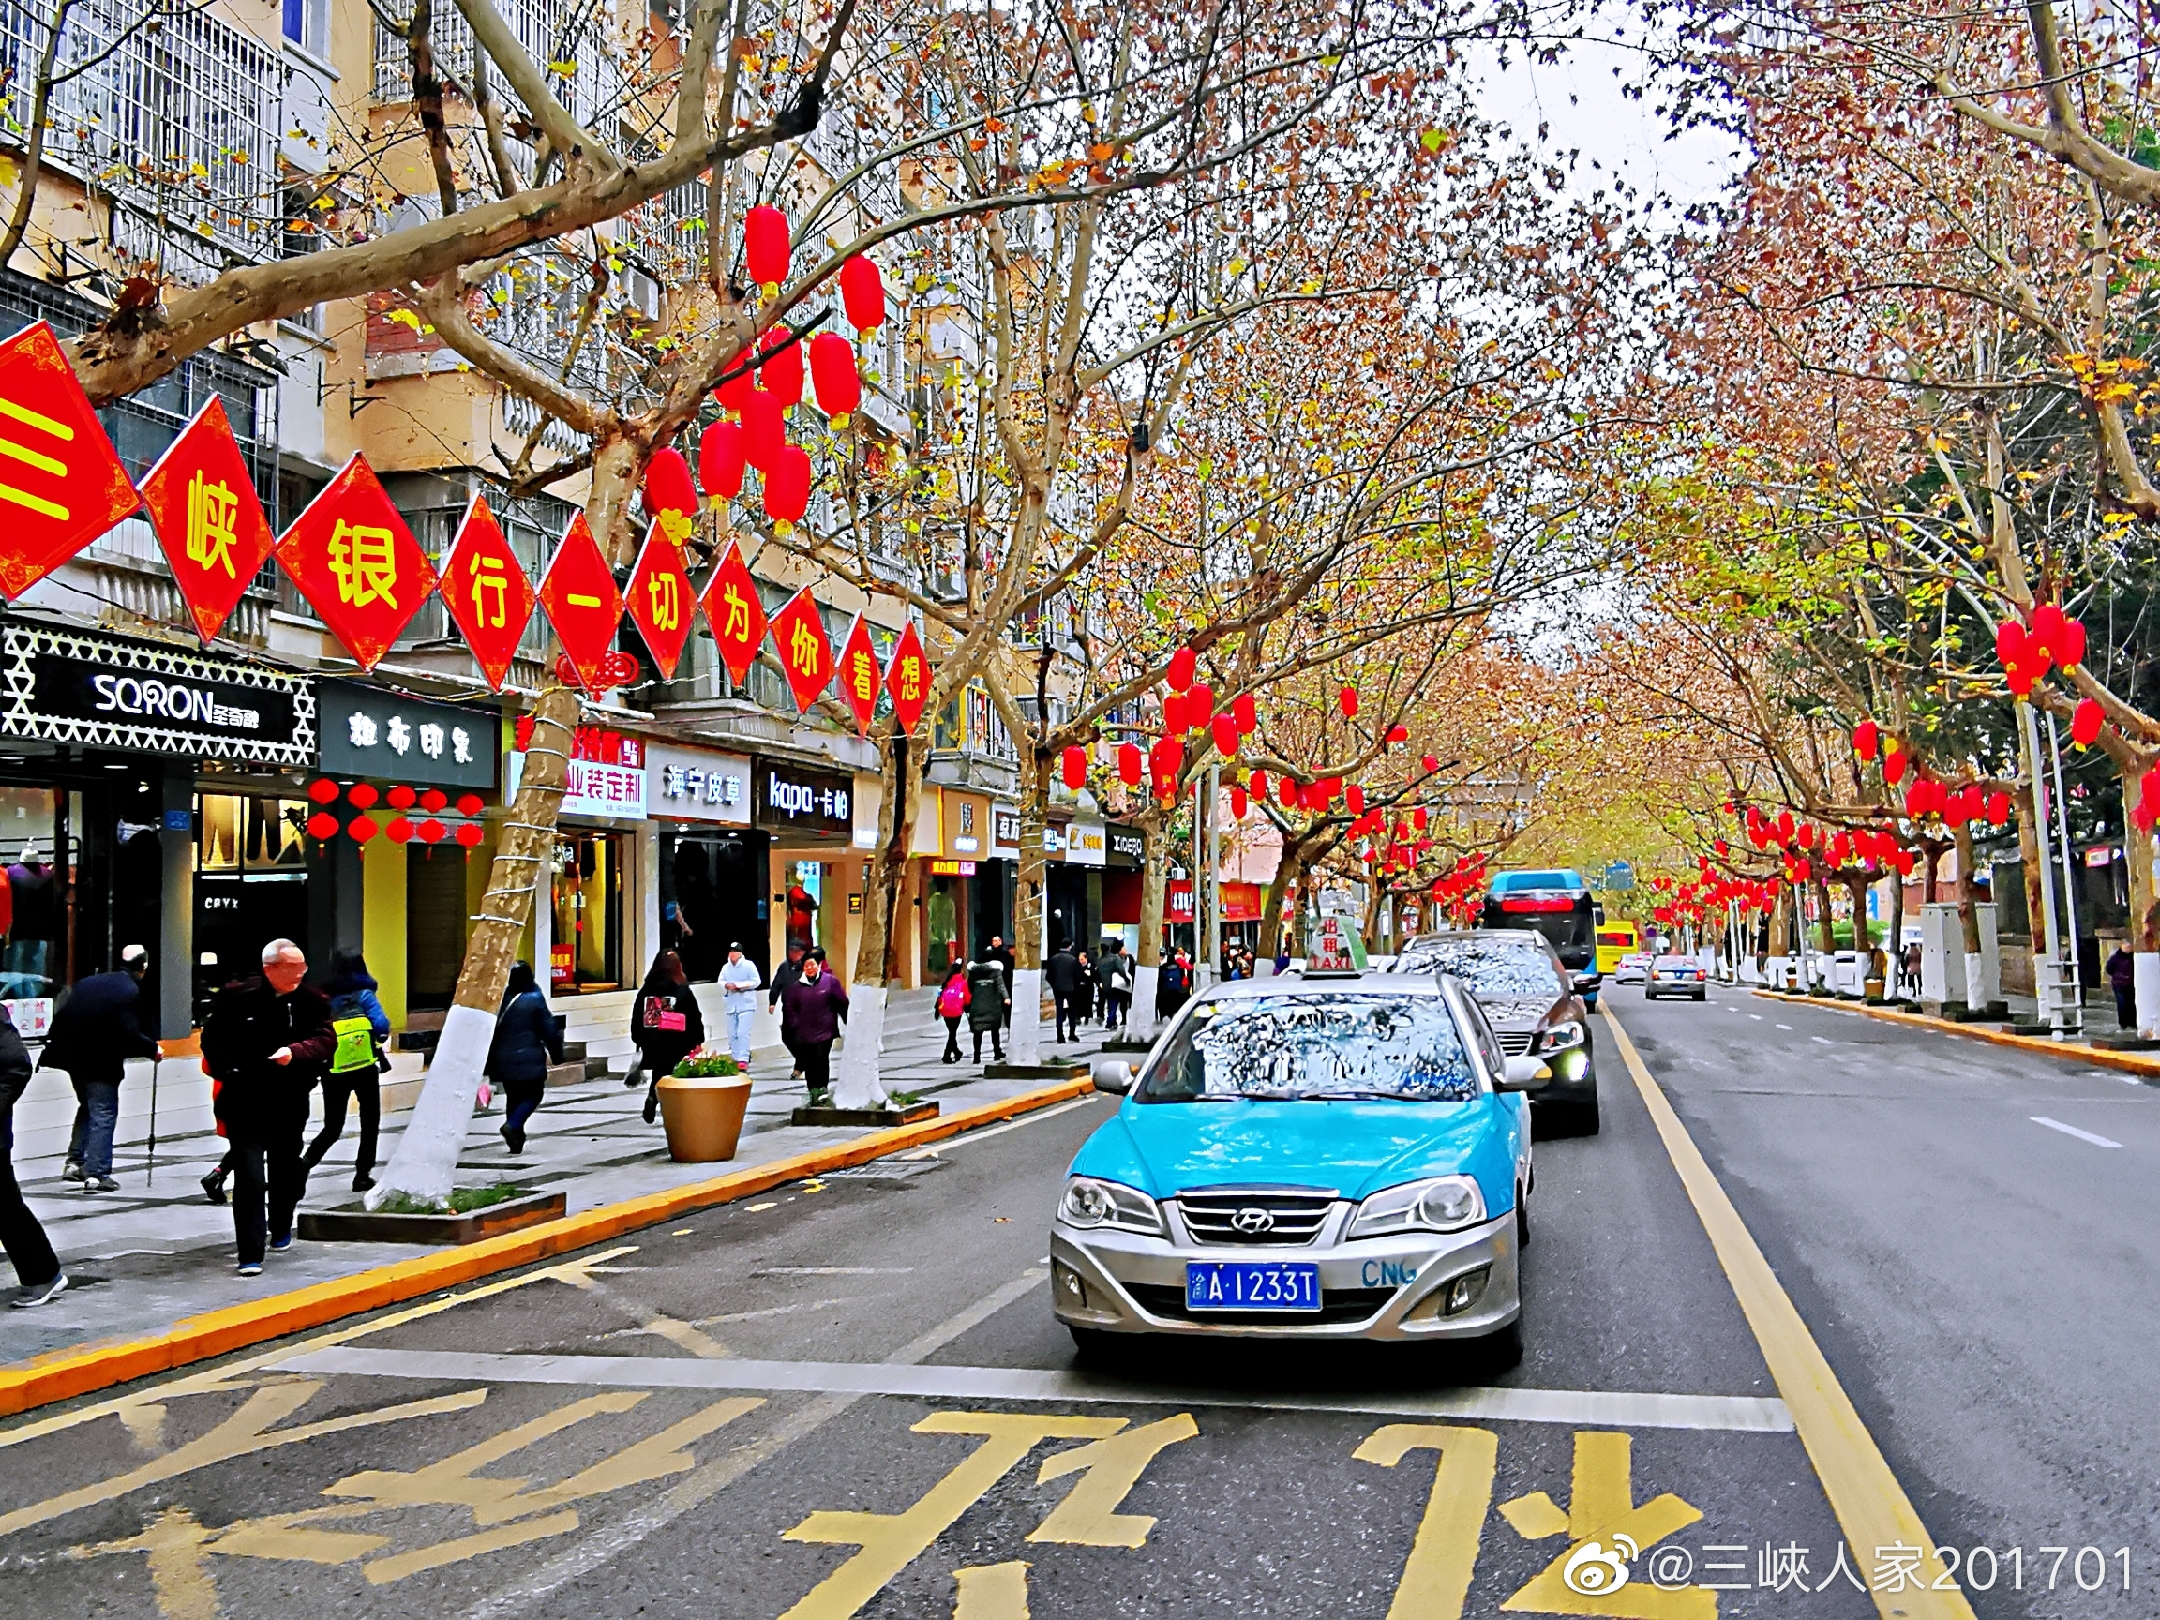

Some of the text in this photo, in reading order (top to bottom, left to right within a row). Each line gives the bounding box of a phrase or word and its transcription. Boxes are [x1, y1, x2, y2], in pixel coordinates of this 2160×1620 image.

[667, 765, 741, 805] 海宁皮草
[1311, 955, 1351, 969] TAXI
[1362, 1260, 1417, 1287] CNG
